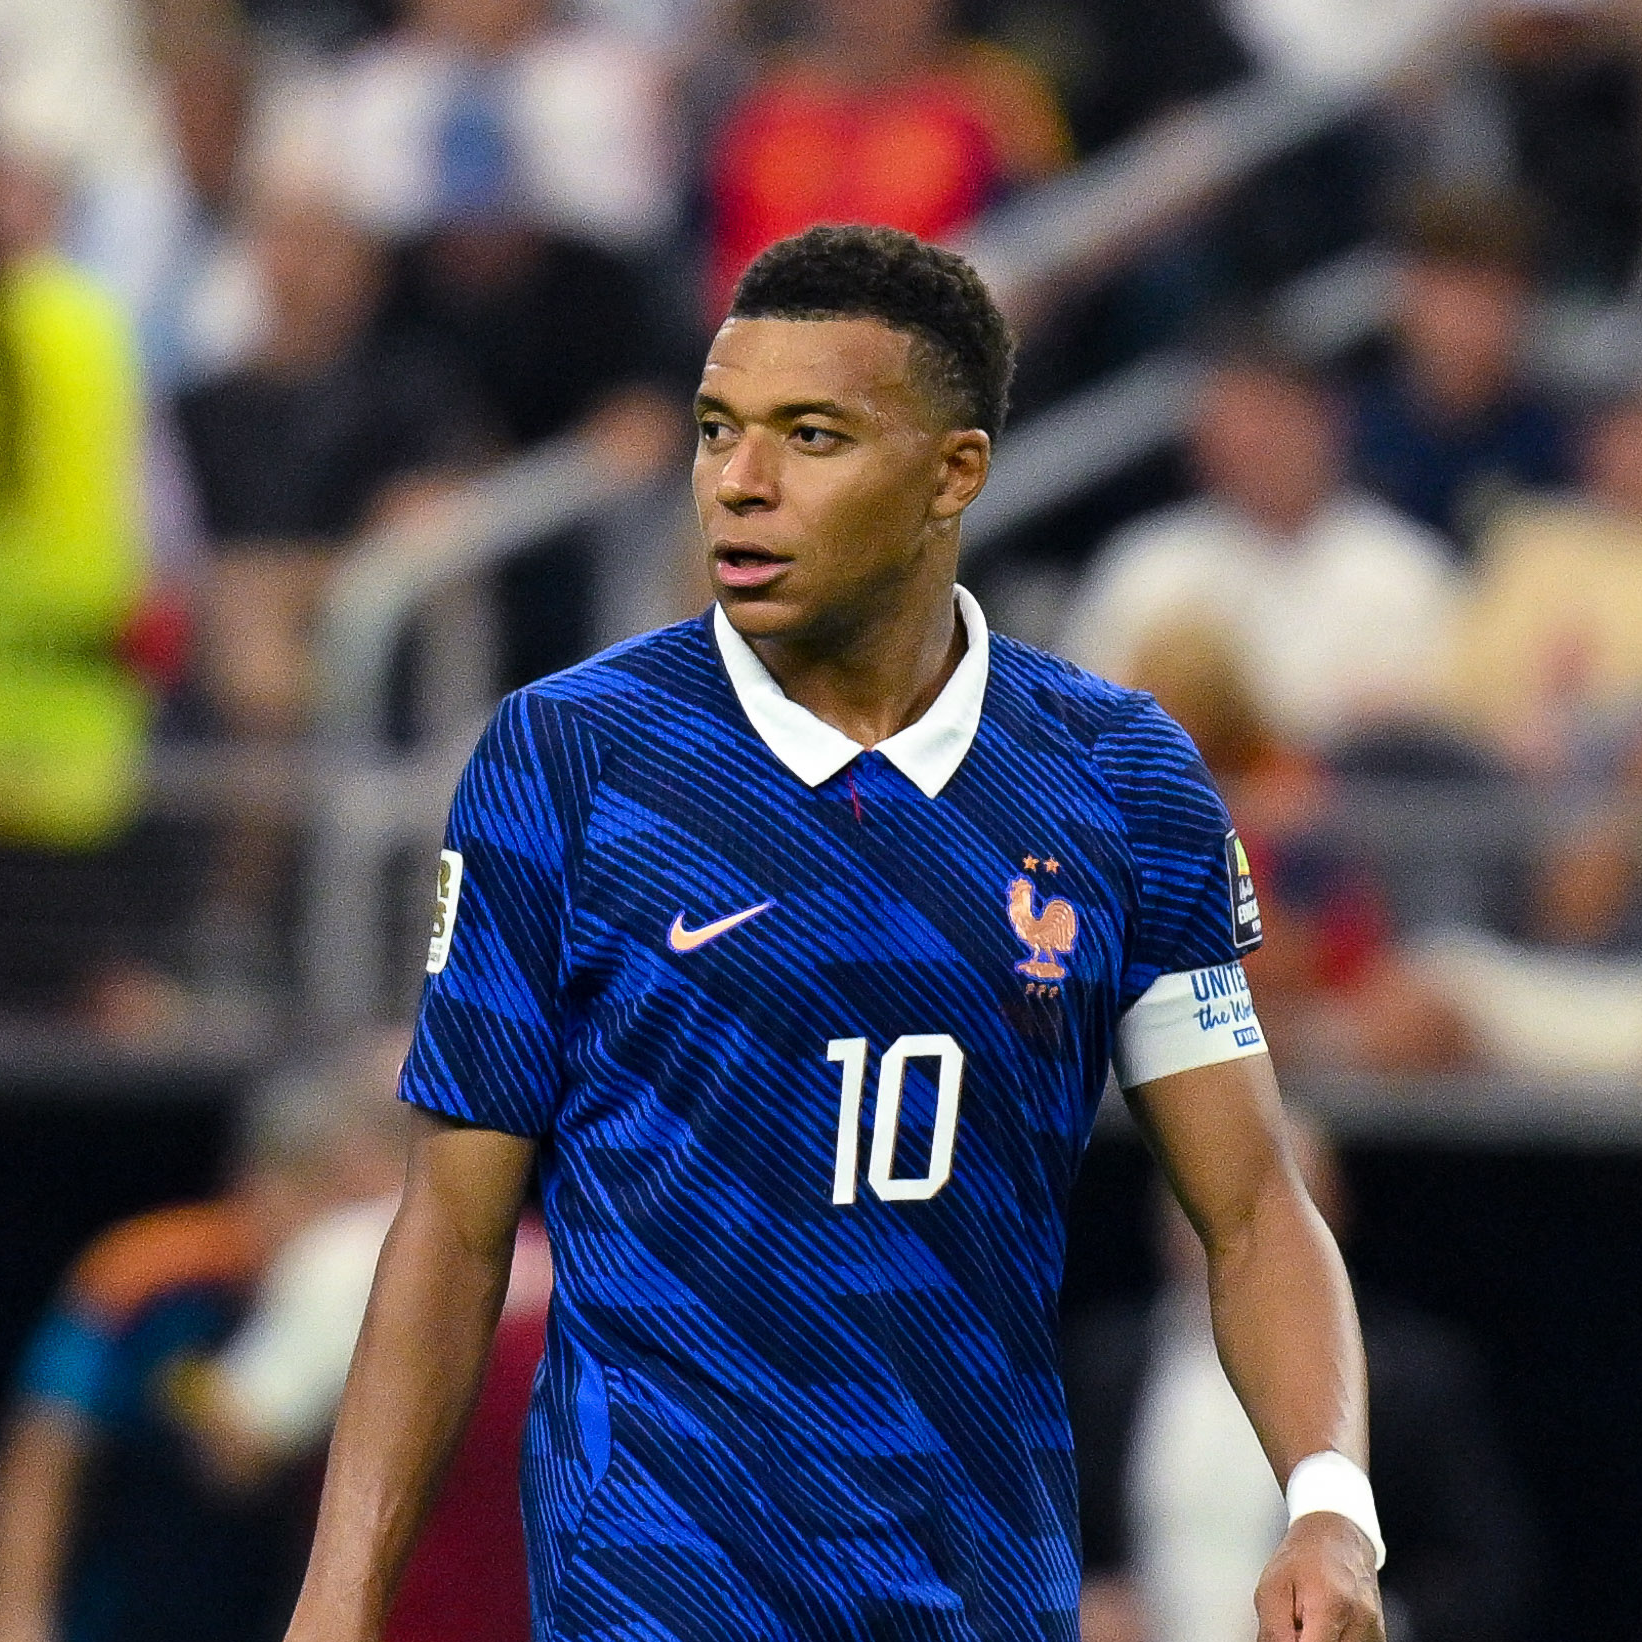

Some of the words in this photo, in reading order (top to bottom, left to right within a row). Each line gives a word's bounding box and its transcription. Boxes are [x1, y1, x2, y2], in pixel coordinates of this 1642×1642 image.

[1191, 962, 1250, 1002] UNITE
[1193, 1003, 1230, 1031] the
[826, 1033, 965, 1205] 10
